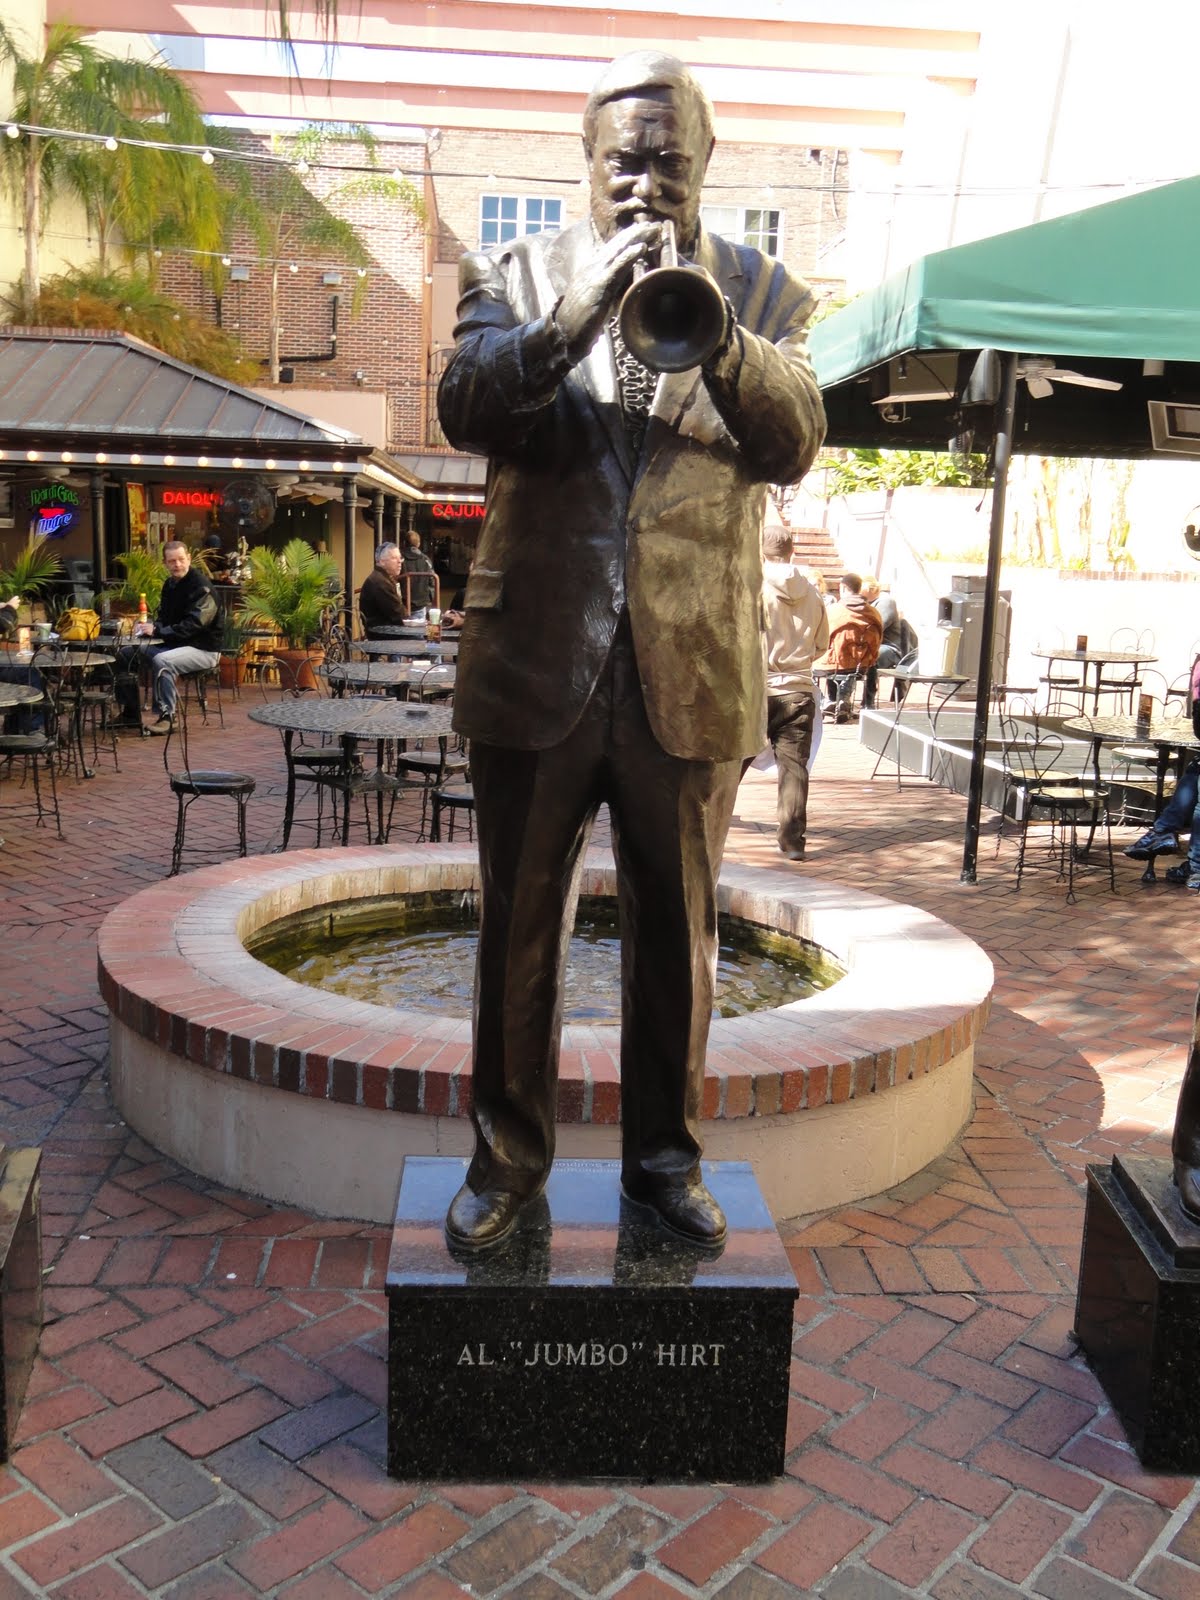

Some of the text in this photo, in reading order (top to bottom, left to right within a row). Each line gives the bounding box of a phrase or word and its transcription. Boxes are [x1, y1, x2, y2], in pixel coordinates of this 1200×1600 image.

[432, 502, 486, 518] CAJUN
[457, 1341, 726, 1367] AL "JUMBO" HIRT
